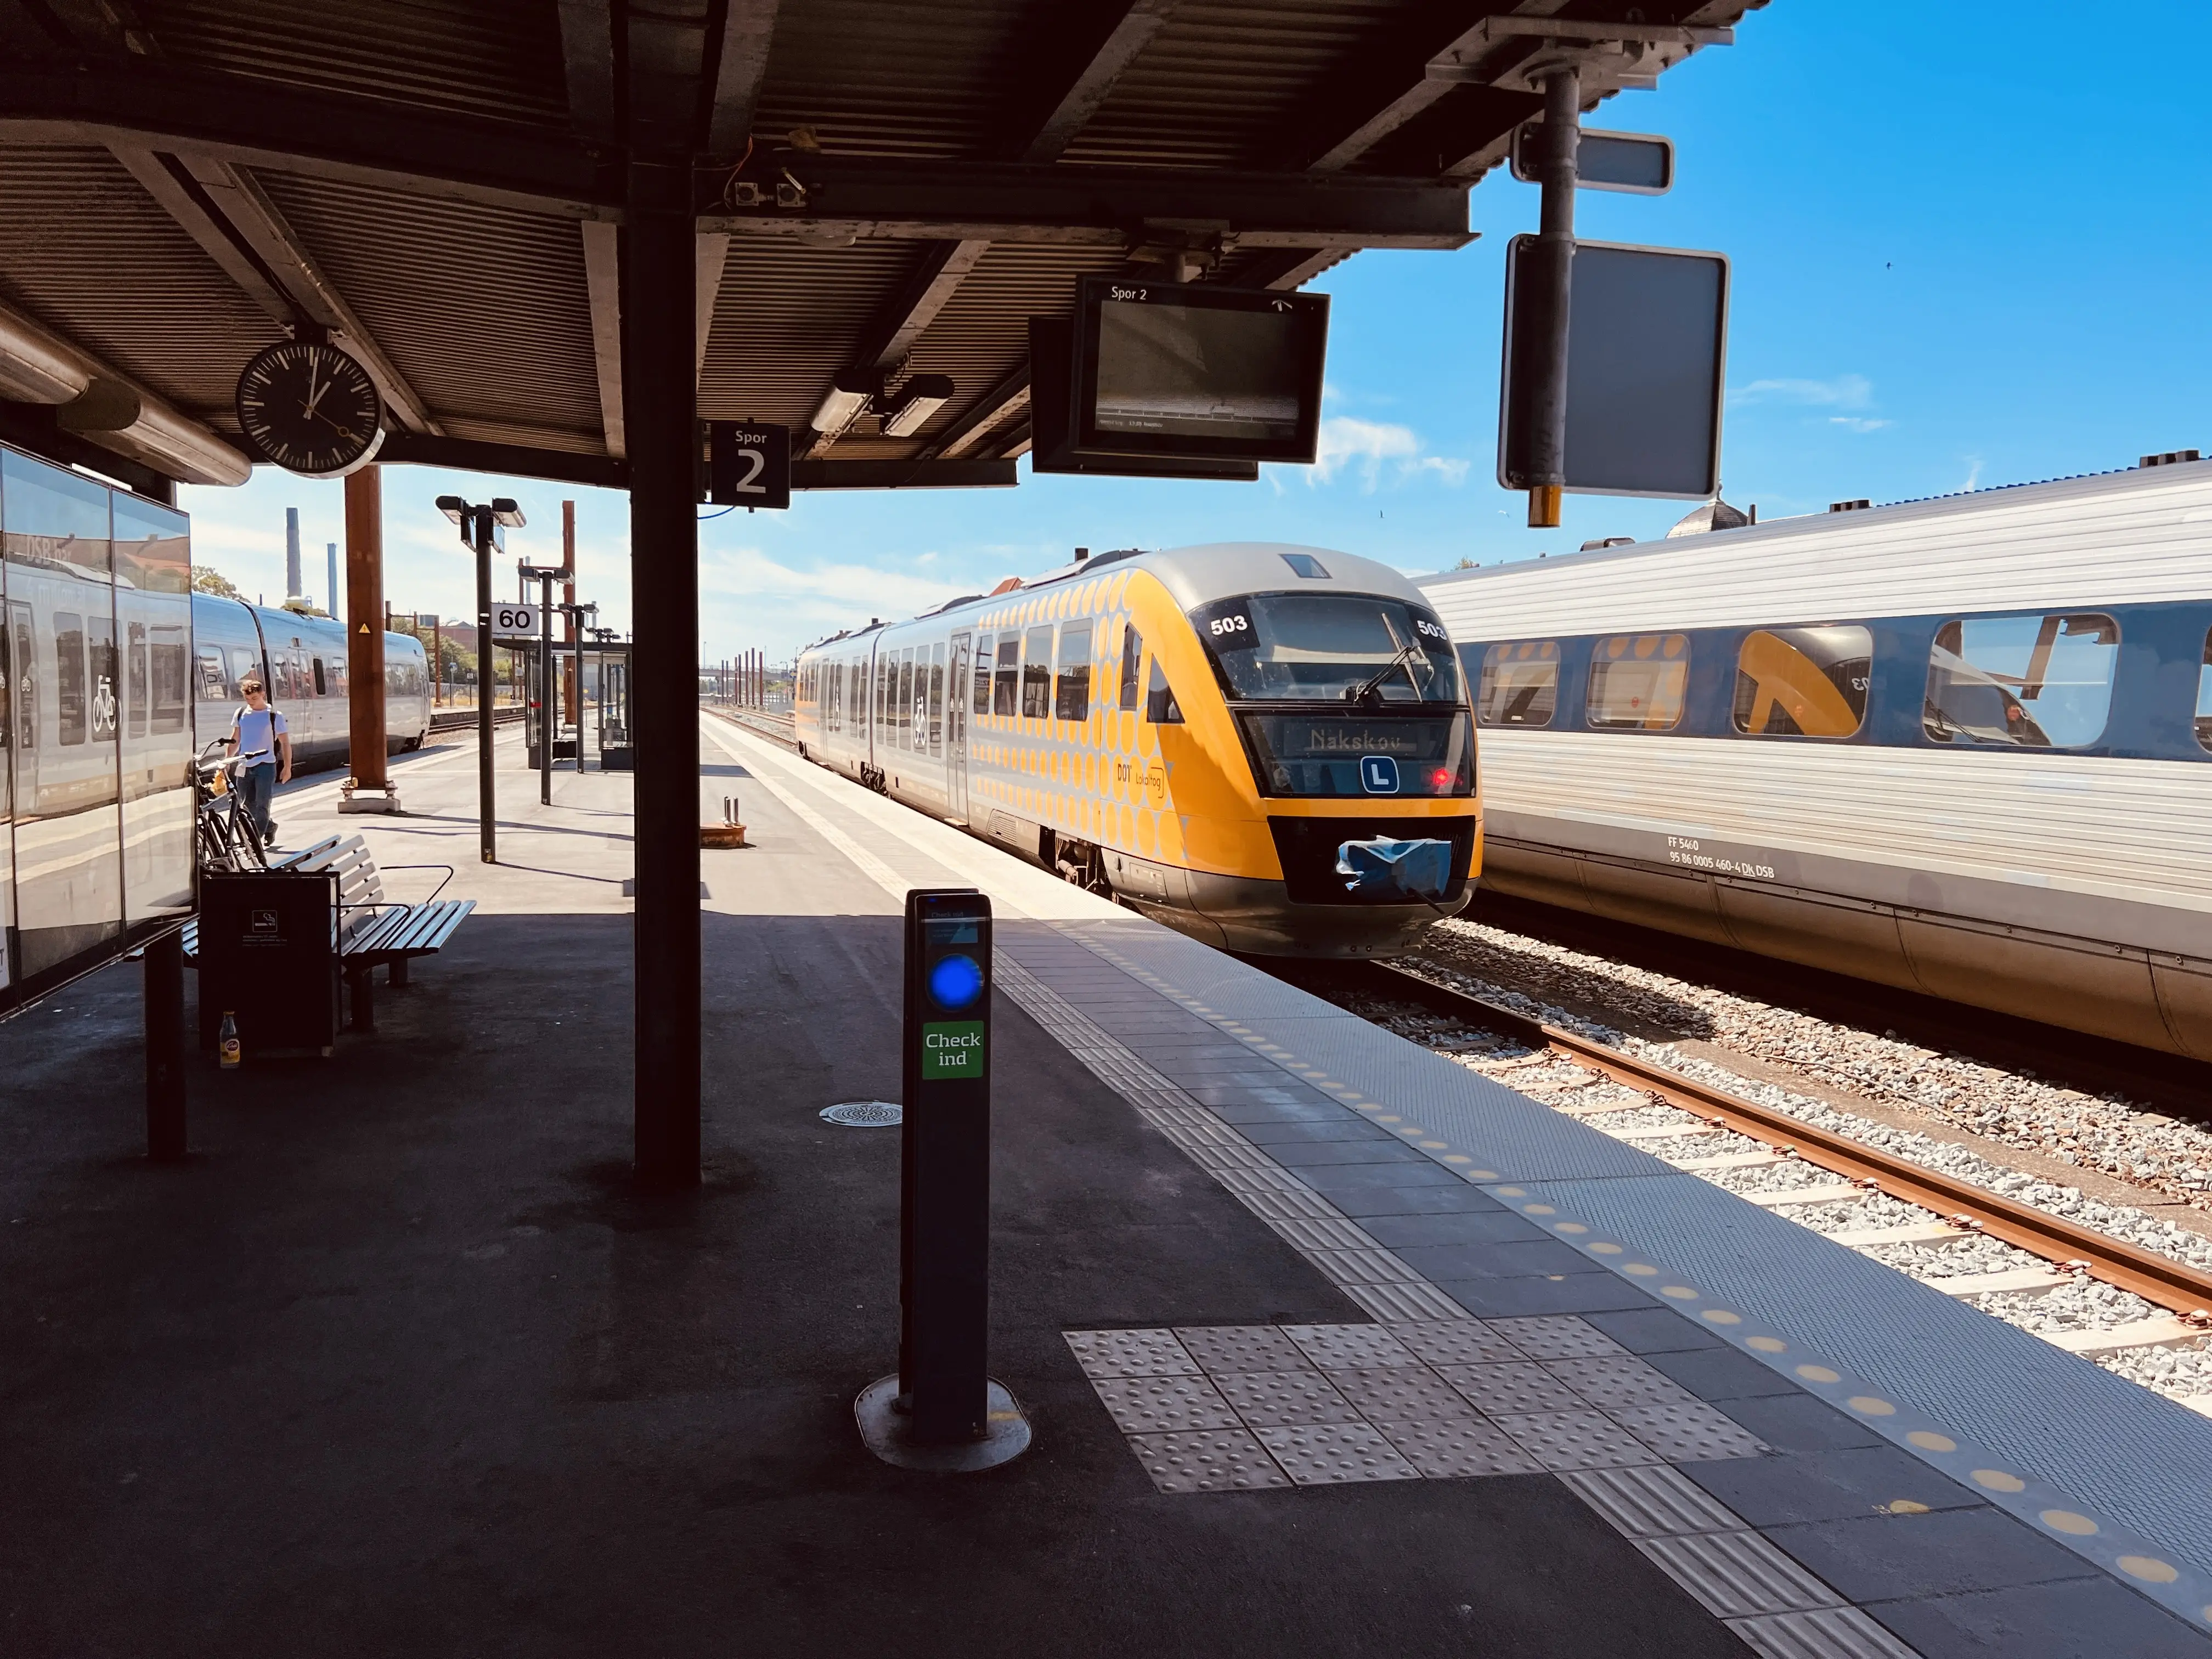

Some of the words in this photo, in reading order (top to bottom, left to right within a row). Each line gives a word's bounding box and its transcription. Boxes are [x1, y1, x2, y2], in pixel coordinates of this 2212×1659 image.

[1111, 286, 1136, 301] Spor
[1139, 289, 1147, 300] 2
[735, 430, 767, 445] Spor
[736, 449, 766, 494] 2
[499, 610, 531, 629] 60
[1210, 615, 1248, 635] 503
[1417, 620, 1447, 640] 503
[1311, 729, 1400, 750] Nakskov
[1136, 772, 1161, 791] Lokaltog
[1371, 764, 1389, 785] L
[1668, 836, 1677, 848] FF
[1679, 838, 1699, 851] 5460
[1669, 851, 1680, 862] 95
[1681, 853, 1692, 865] 86
[1692, 854, 1714, 868] 0005
[1716, 859, 1741, 873] 460-4
[1756, 865, 1775, 878] DSB
[926, 1032, 980, 1048] Check
[939, 1051, 967, 1066] ind
